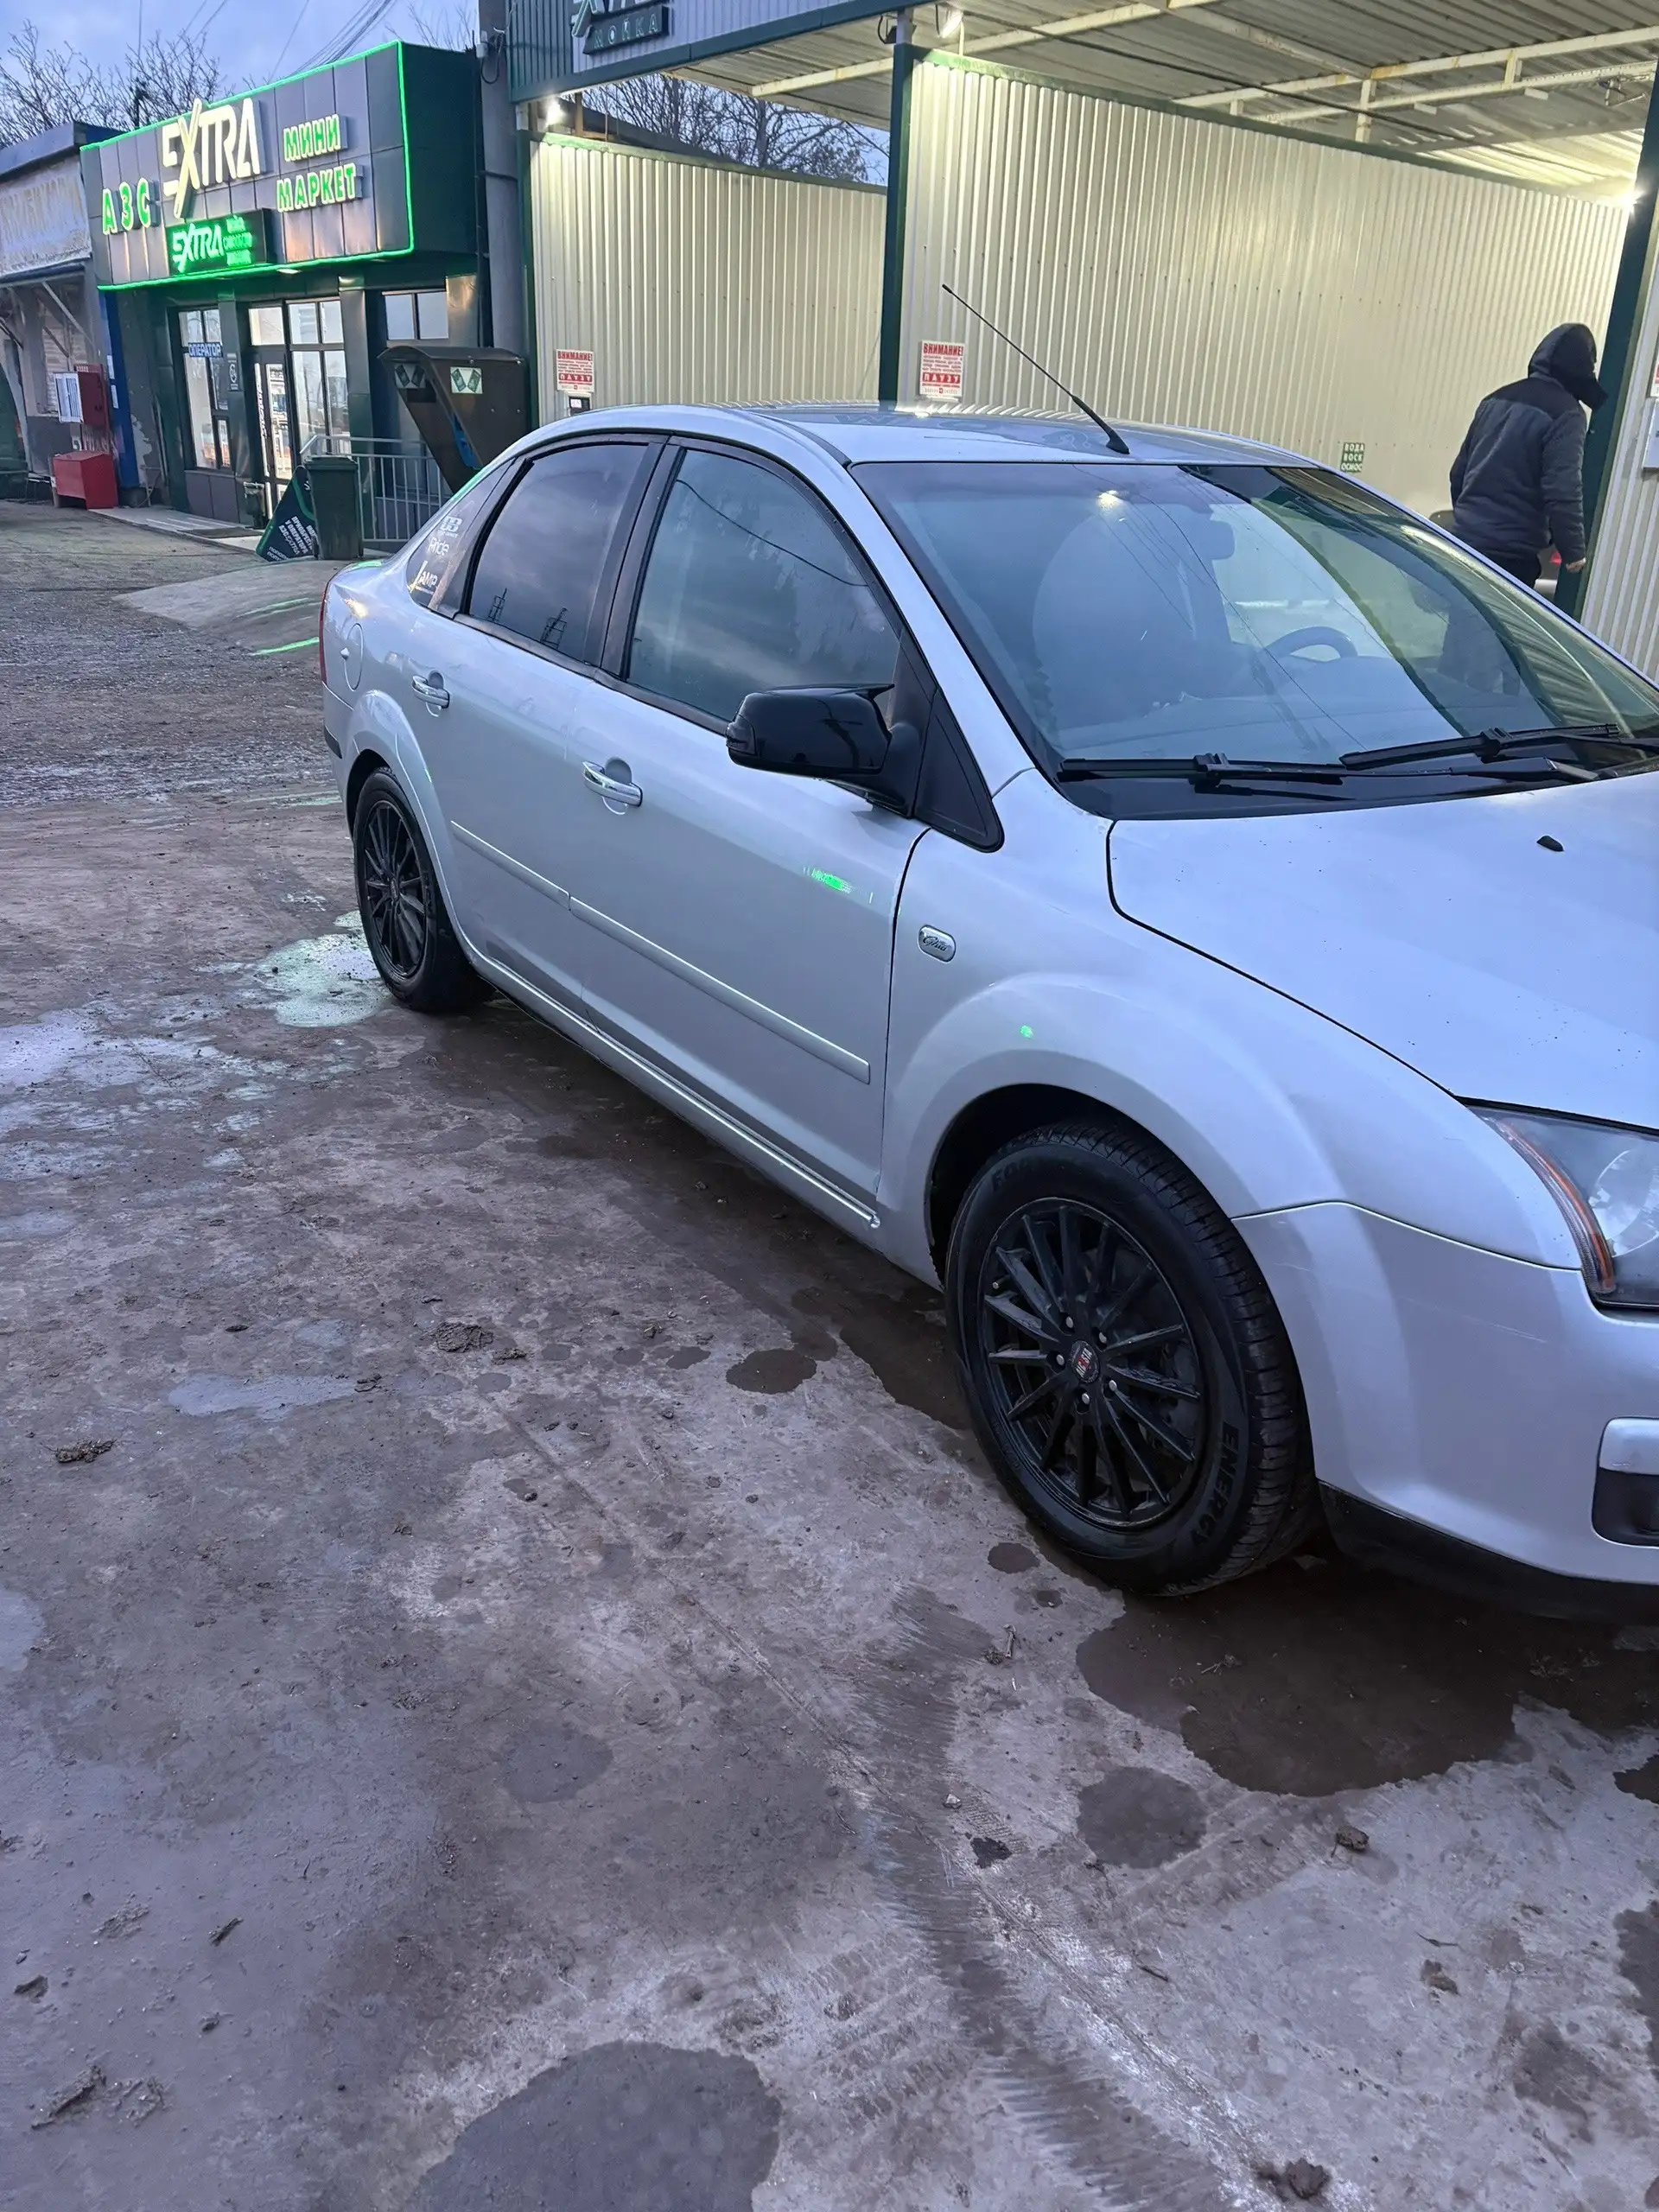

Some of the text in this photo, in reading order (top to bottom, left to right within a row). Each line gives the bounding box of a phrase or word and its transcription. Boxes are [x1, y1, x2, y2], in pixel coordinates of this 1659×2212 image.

[594, 13, 658, 49] МОЙКА
[162, 98, 261, 219] EXTRA
[283, 113, 342, 162] МИНИ
[276, 162, 357, 213] МАРКЕТ
[172, 222, 226, 273] EXTRA
[189, 342, 221, 357] ОПЕРАТОР
[923, 343, 964, 356] ВНИМАНИЕ!
[924, 373, 959, 383] ПАУЗУ
[1191, 1420, 1240, 1547] ENERGY
